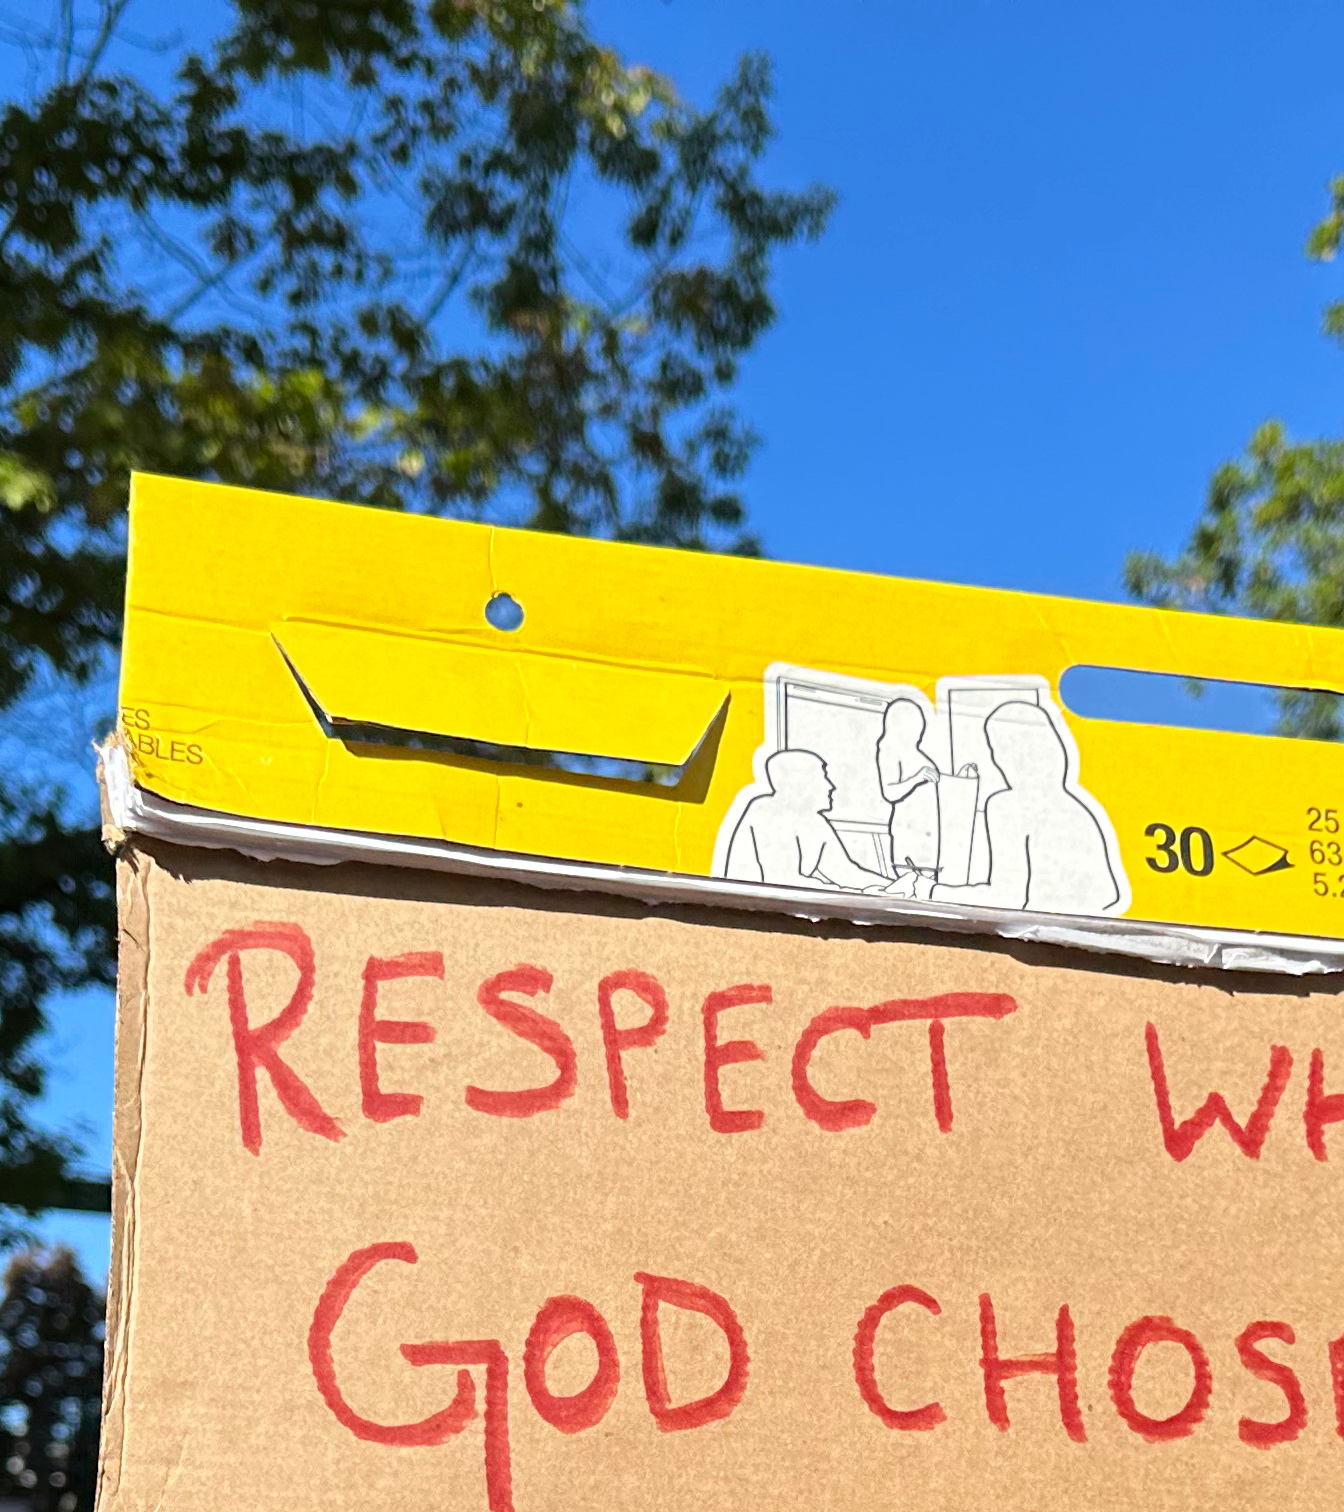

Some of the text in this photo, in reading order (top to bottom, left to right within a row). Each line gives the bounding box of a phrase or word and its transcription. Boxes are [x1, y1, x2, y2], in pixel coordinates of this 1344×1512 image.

[1306, 807, 1340, 834] 25
[1144, 822, 1216, 878] 30
[184, 920, 1018, 1157] RESPECT
